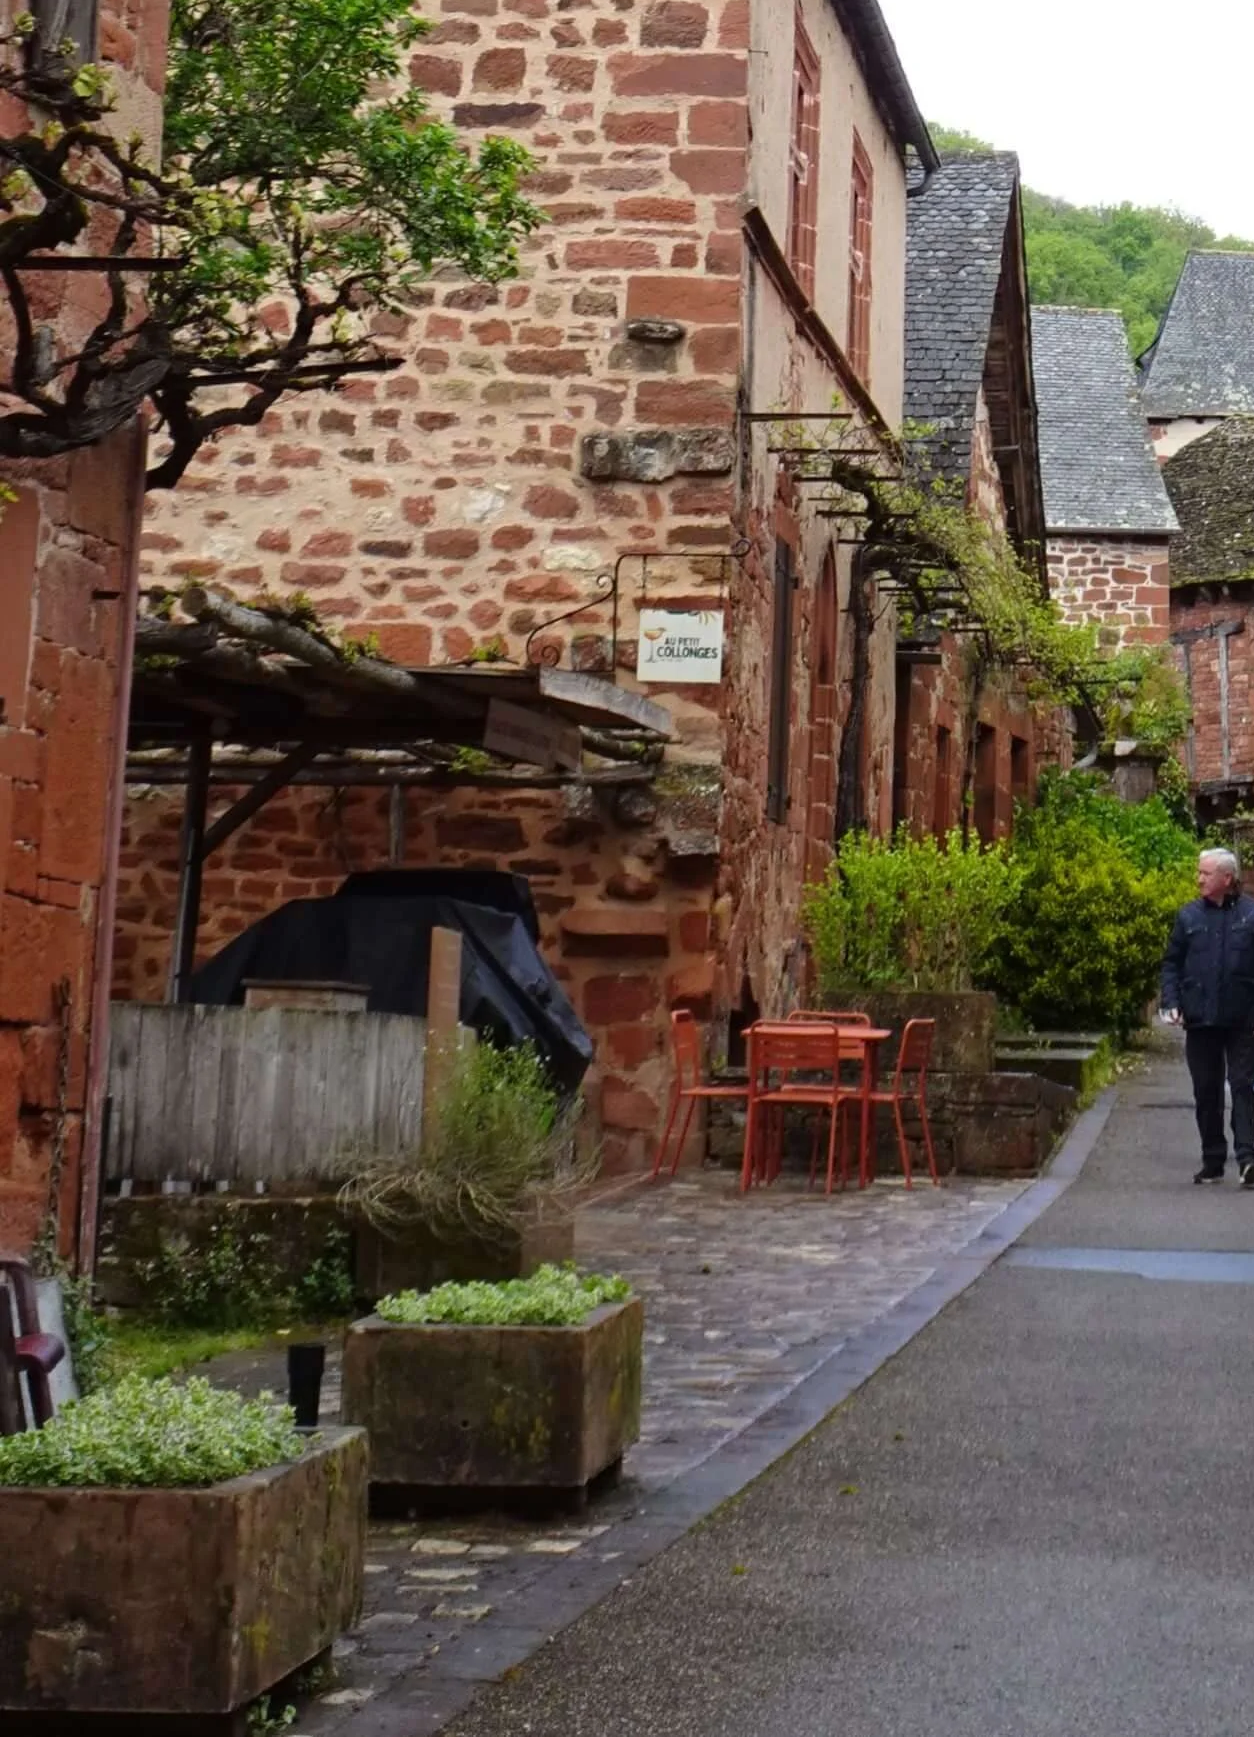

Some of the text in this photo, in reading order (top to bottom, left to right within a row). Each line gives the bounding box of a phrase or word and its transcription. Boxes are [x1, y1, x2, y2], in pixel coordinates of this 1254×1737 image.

[665, 637, 701, 647] AU PETIT
[657, 646, 718, 659] COLLONGES
